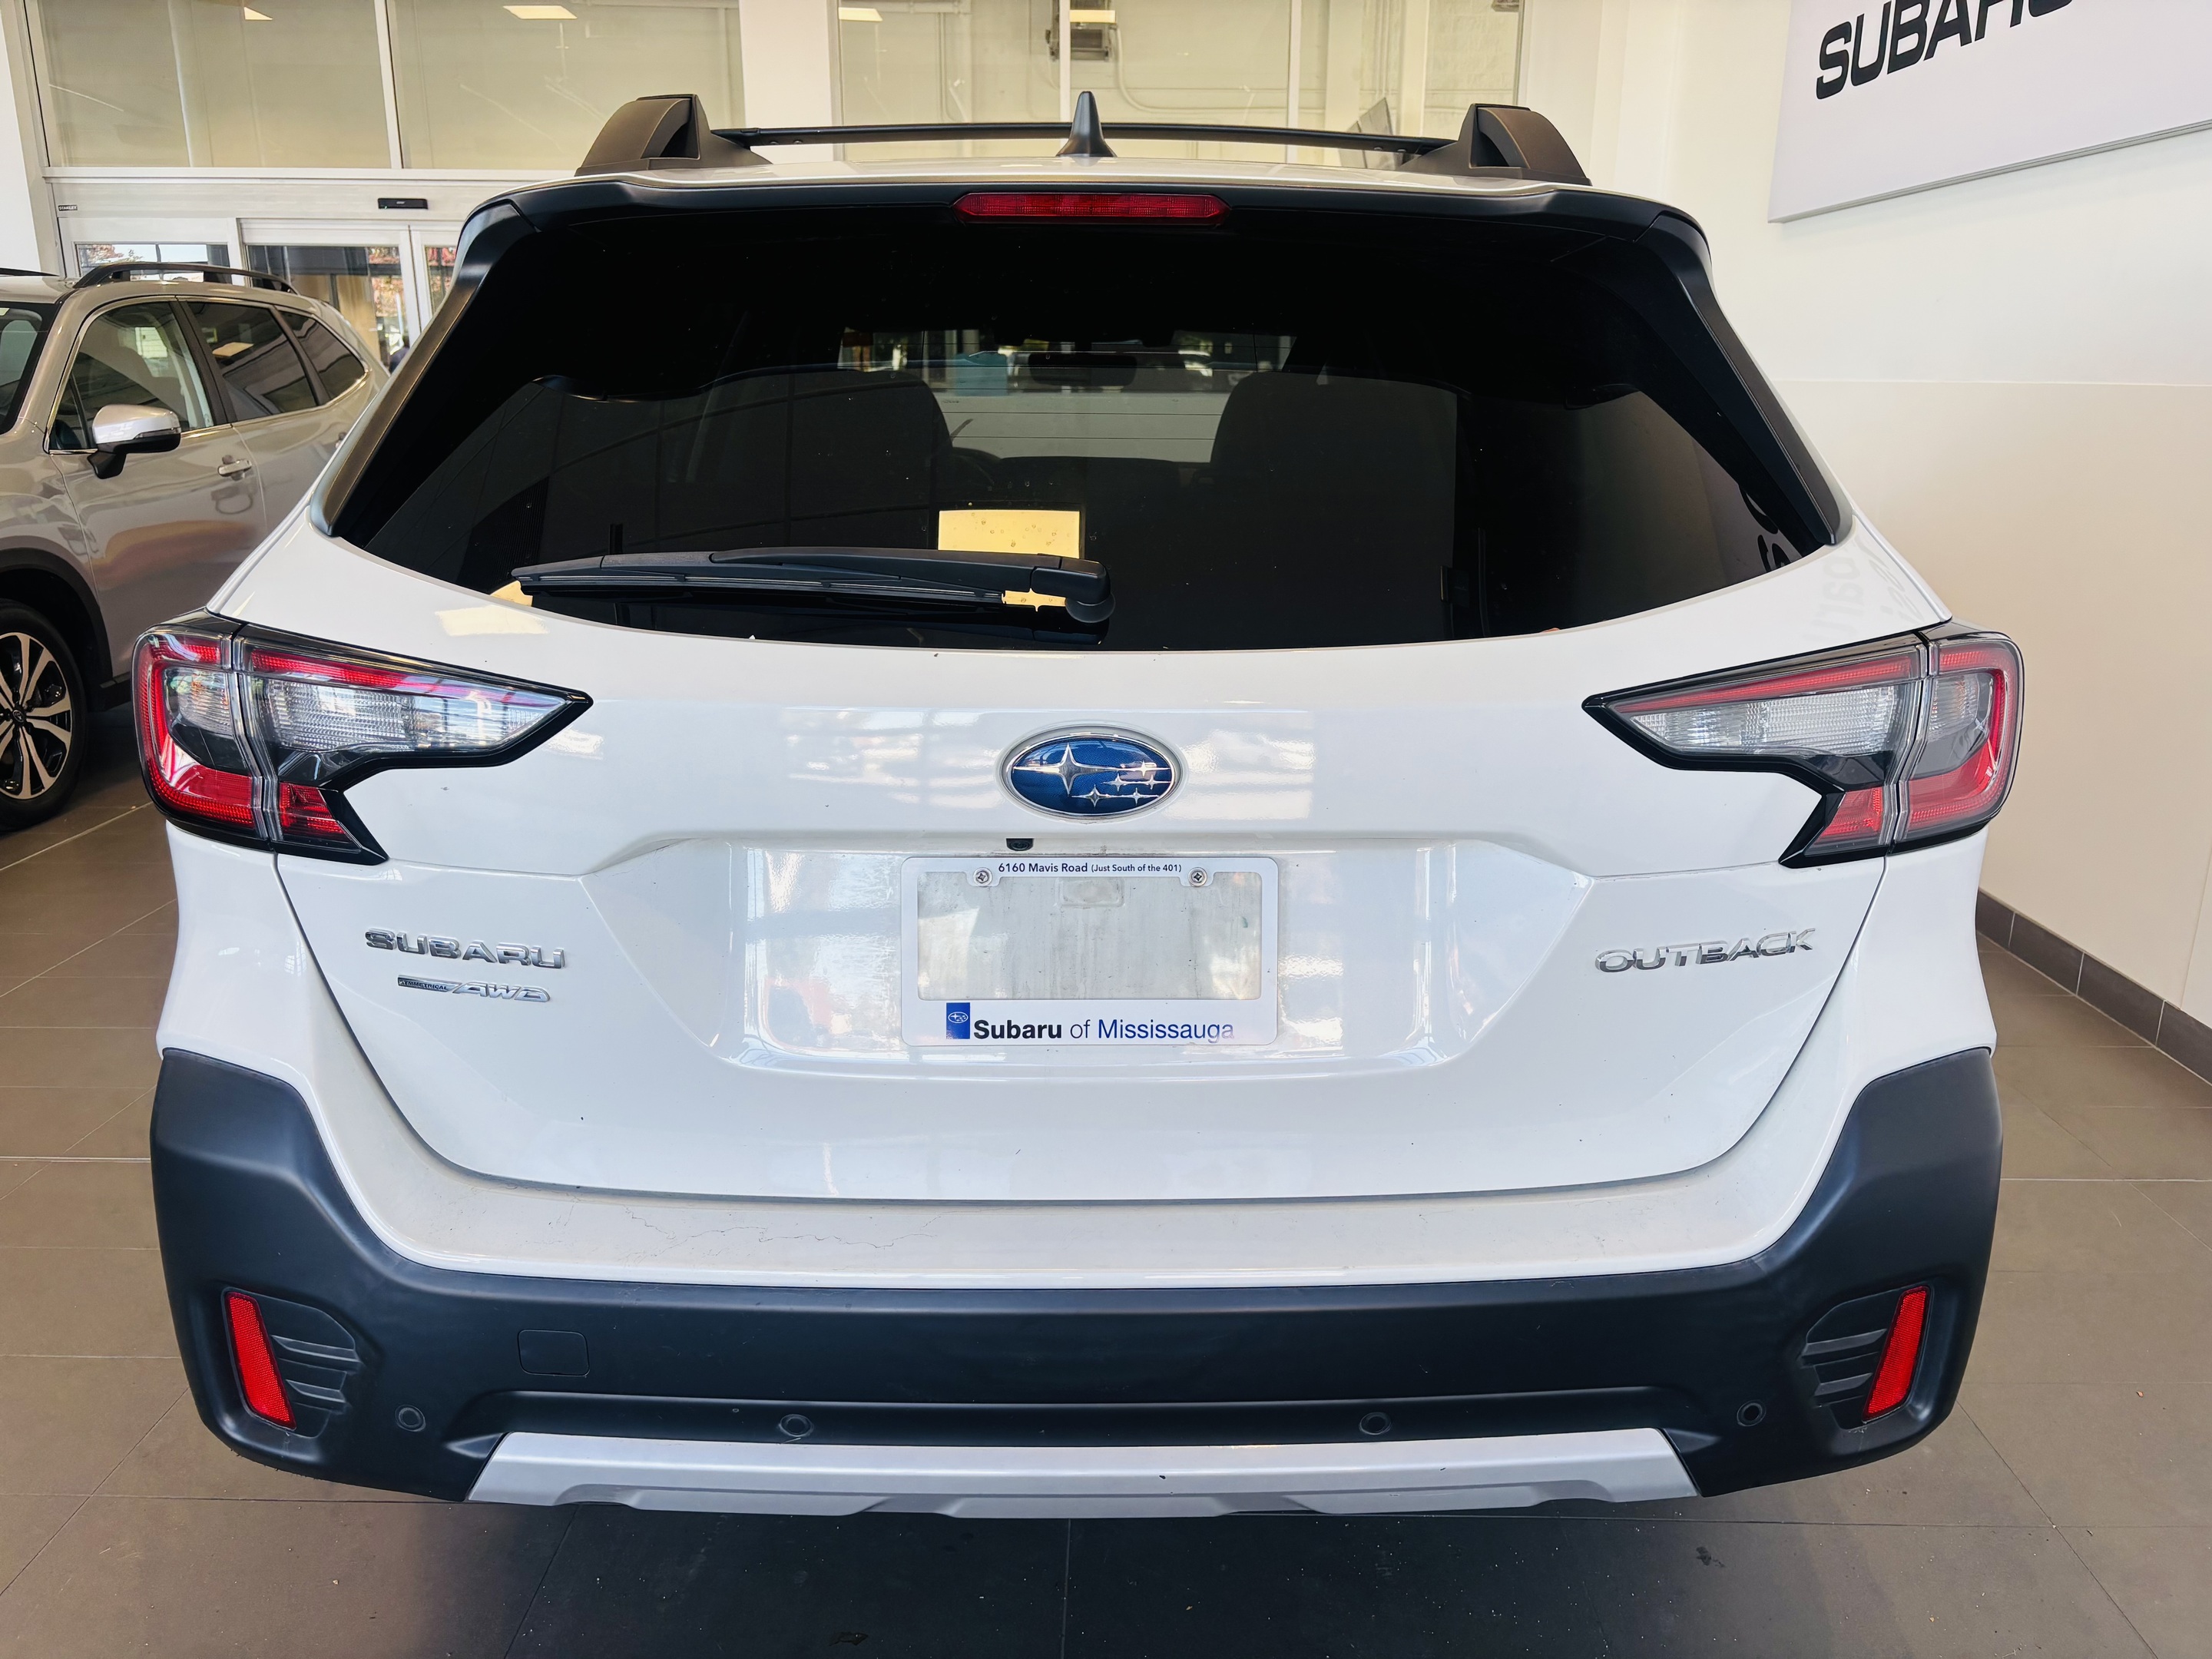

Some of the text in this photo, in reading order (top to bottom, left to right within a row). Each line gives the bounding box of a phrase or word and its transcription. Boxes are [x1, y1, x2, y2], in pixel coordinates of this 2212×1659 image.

[1816, 0, 2073, 99] SUBA
[998, 863, 1025, 873] 6160
[1029, 863, 1058, 873] Mavis
[1061, 862, 1088, 873] Road
[1091, 864, 1110, 873] (Just
[1163, 864, 1182, 873] 401)
[365, 928, 565, 969] SUBARU
[1595, 928, 1816, 972] OUTBACK
[452, 982, 550, 1002] AWD
[973, 1018, 1236, 1044] Subaru of Mississauga
